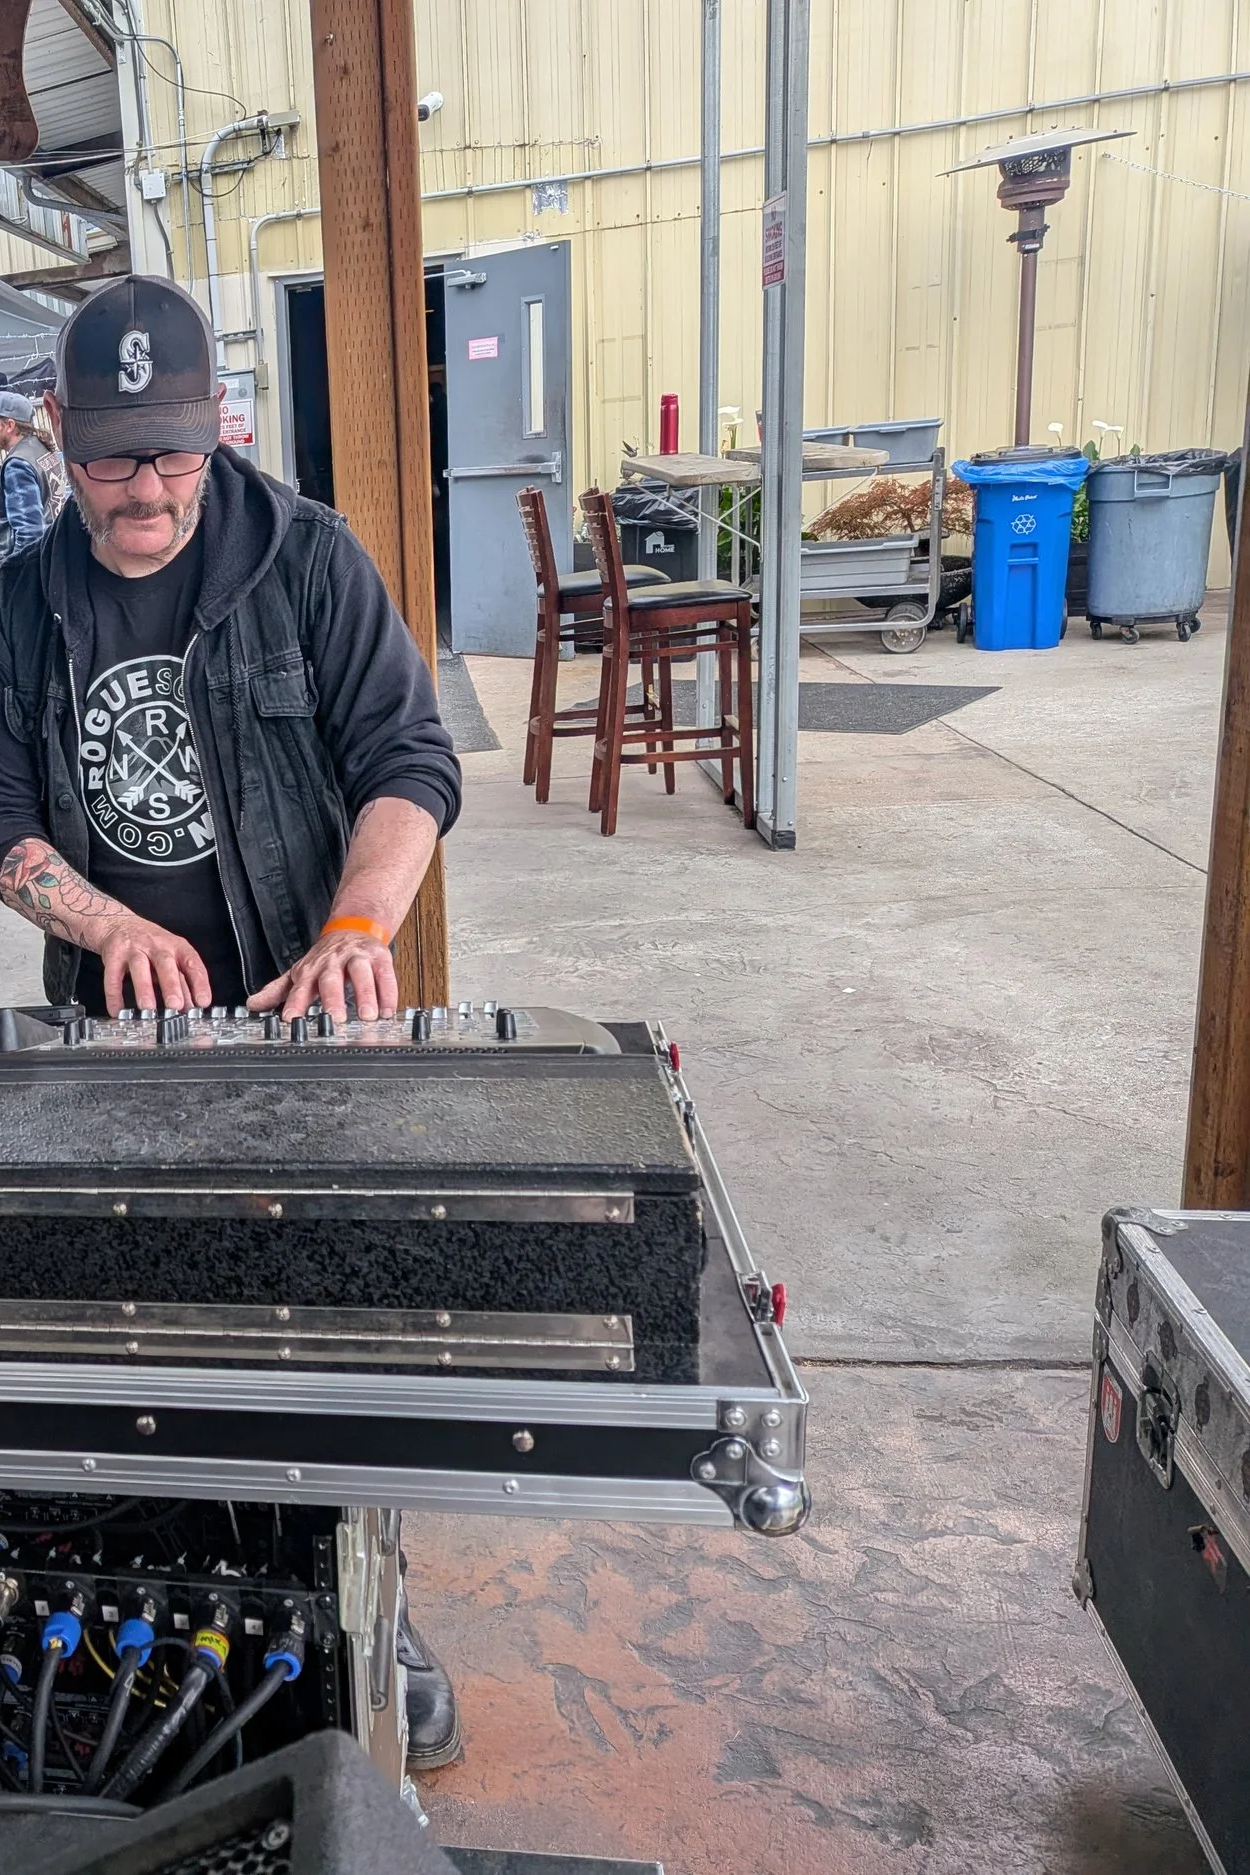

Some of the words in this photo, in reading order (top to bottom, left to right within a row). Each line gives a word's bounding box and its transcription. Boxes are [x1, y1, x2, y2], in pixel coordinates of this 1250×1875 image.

[118, 330, 153, 393] S
[222, 413, 245, 424] KING
[145, 709, 169, 735] R
[149, 793, 171, 819] S
